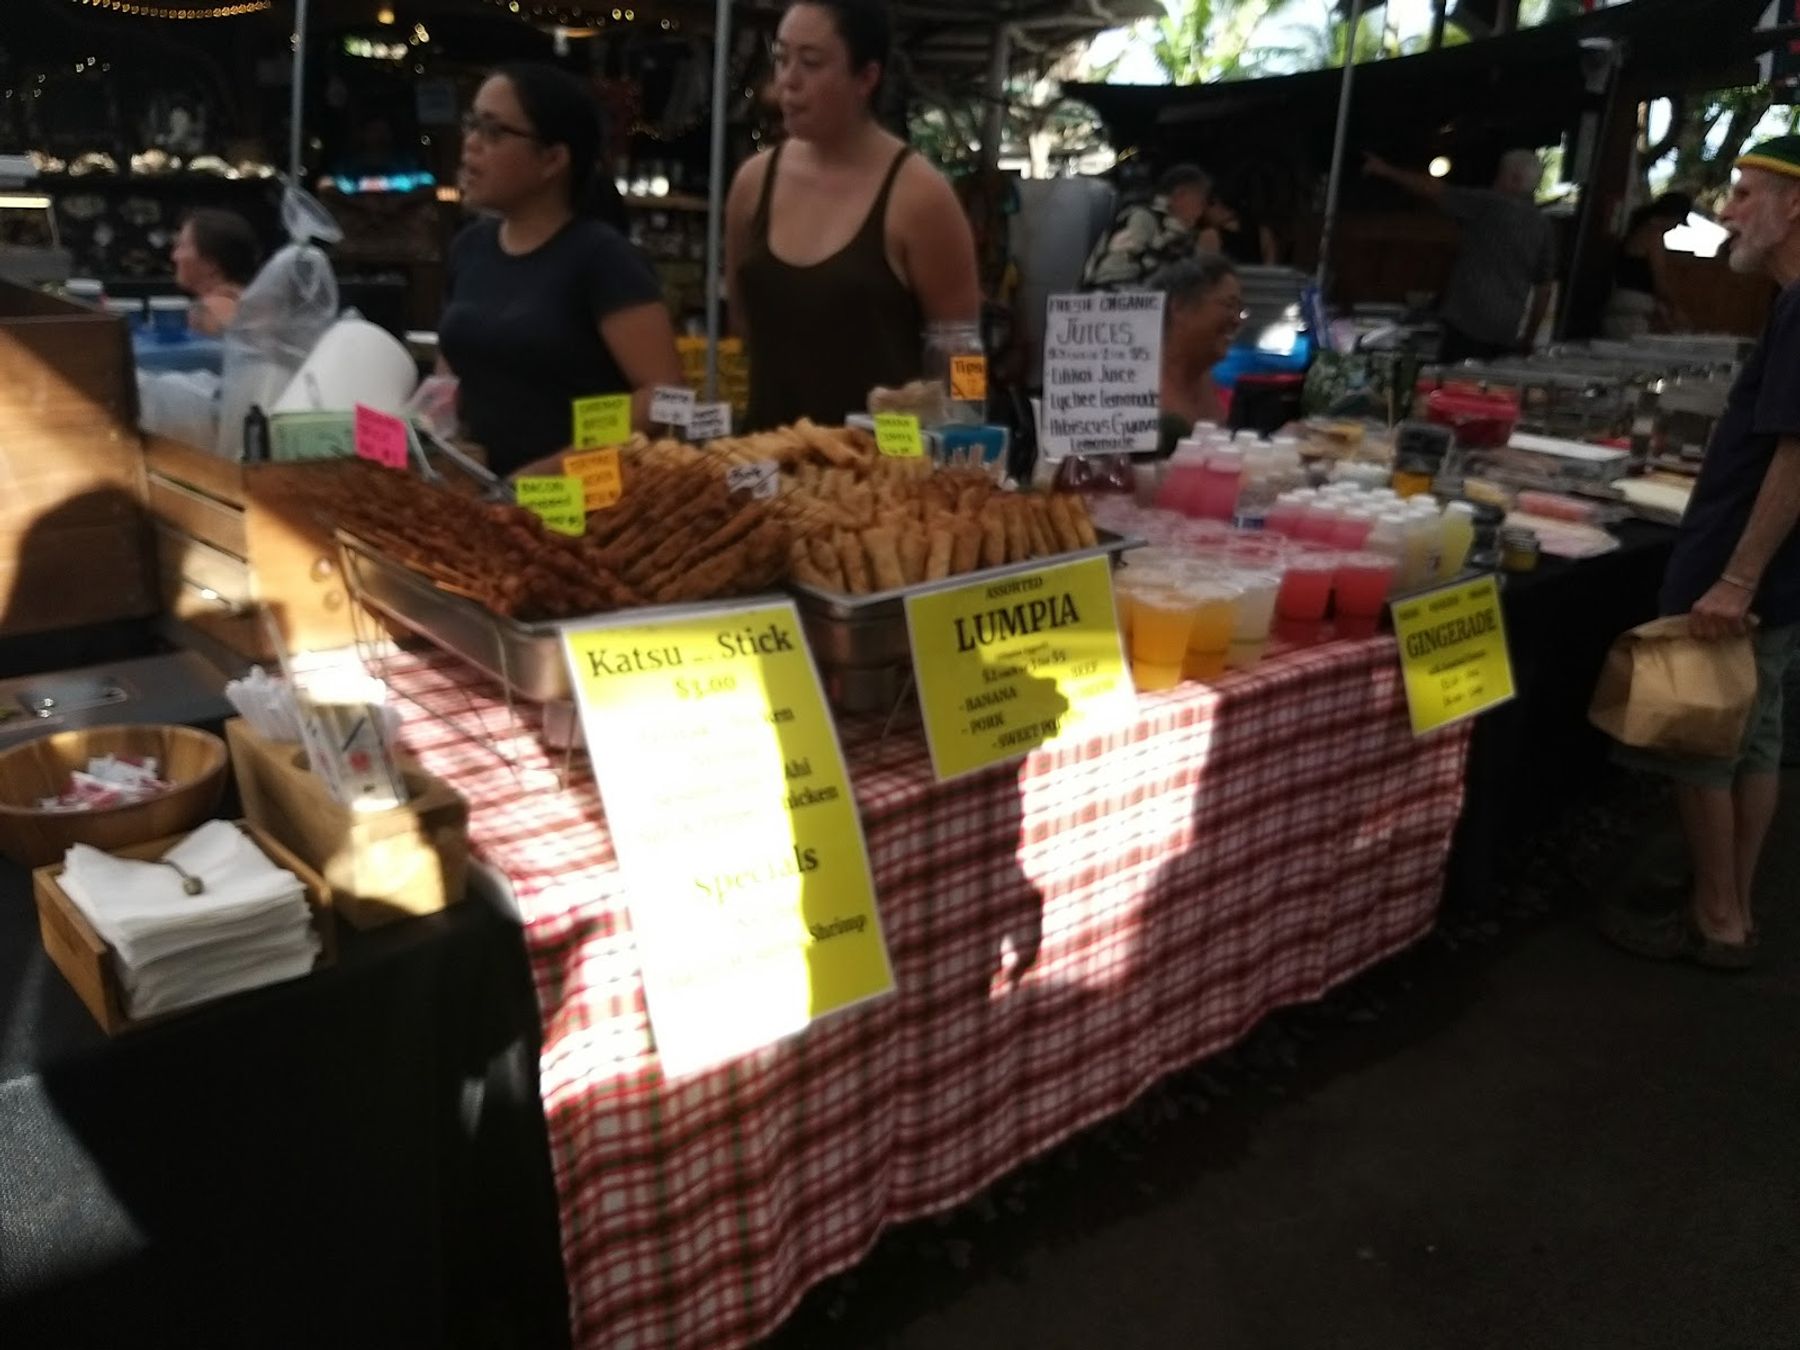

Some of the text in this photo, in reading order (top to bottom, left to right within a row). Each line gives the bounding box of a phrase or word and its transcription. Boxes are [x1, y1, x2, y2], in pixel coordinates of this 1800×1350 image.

[1099, 296, 1161, 312] ORGANIC
[1056, 317, 1136, 346] JUICES
[954, 593, 1080, 652] LUMPIA
[1406, 607, 1498, 659] GINGERADE
[586, 623, 794, 677] Katsu Stick
